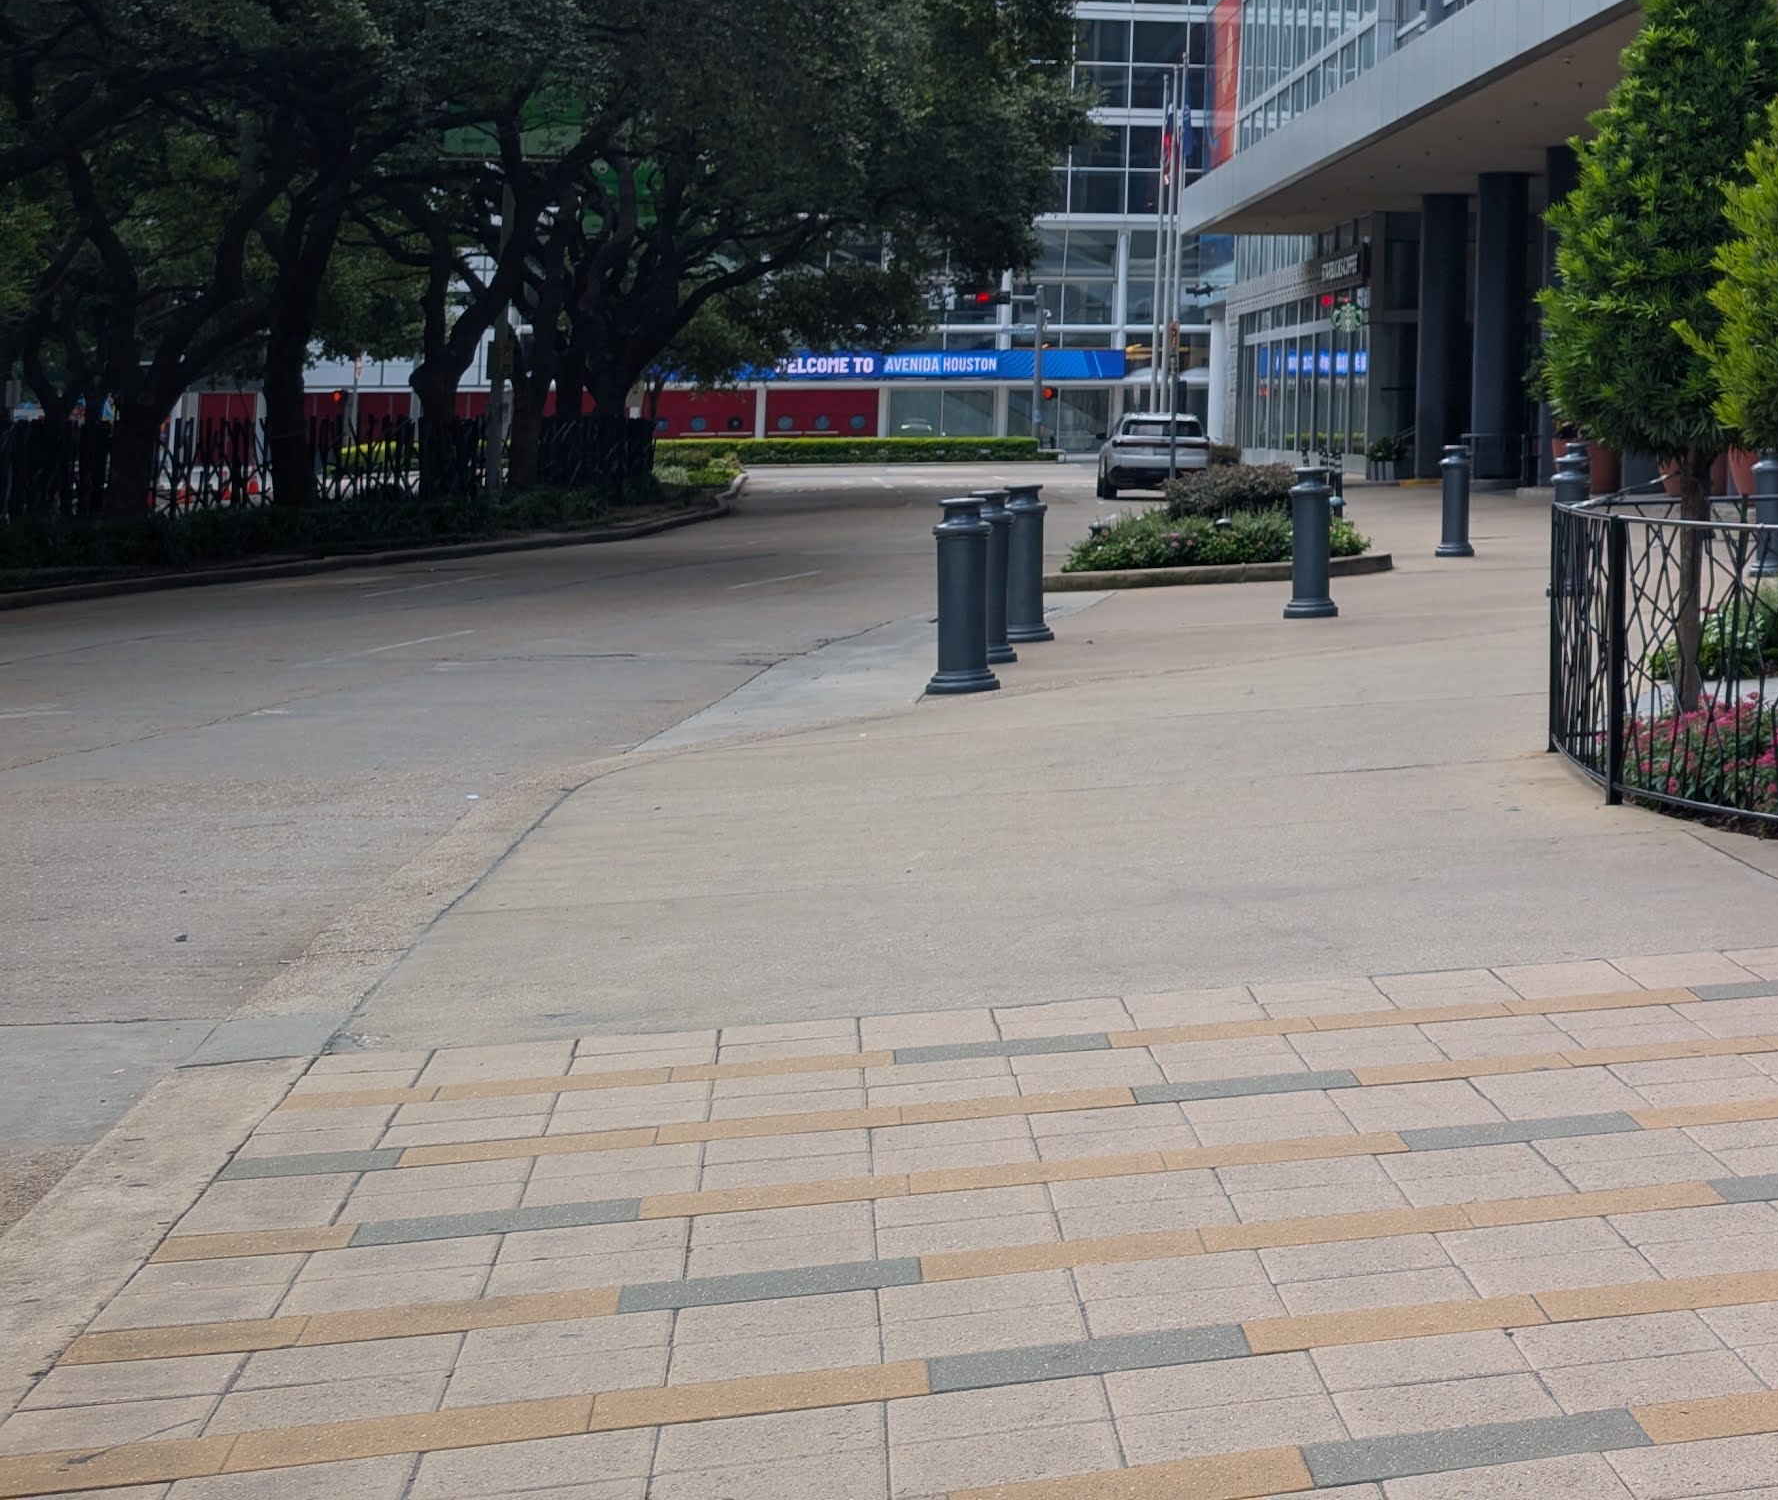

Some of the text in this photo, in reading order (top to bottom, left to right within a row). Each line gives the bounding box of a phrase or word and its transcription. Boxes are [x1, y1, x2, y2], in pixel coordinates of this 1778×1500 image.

[852, 357, 874, 374] TO
[884, 356, 940, 373] AVENIDA
[942, 357, 998, 373] HOUSTON
